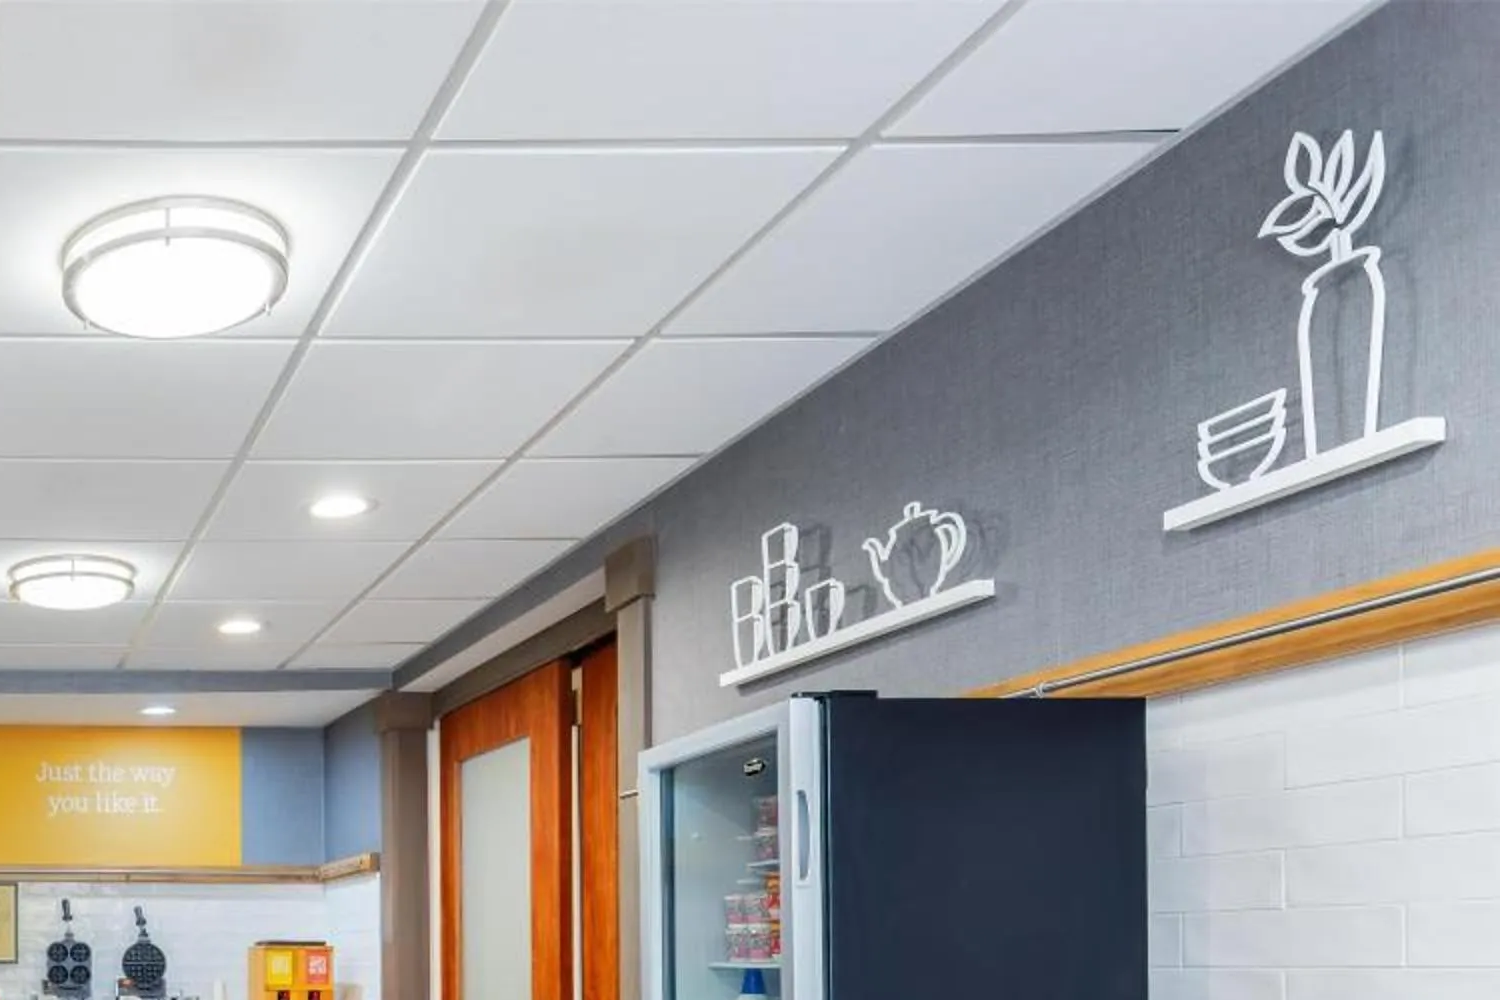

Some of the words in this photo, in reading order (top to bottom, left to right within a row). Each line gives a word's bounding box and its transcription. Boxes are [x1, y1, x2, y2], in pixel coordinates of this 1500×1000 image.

[35, 761, 83, 783] Just
[88, 760, 125, 783] the
[129, 765, 176, 788] way
[47, 795, 88, 818] you
[95, 791, 137, 814] like
